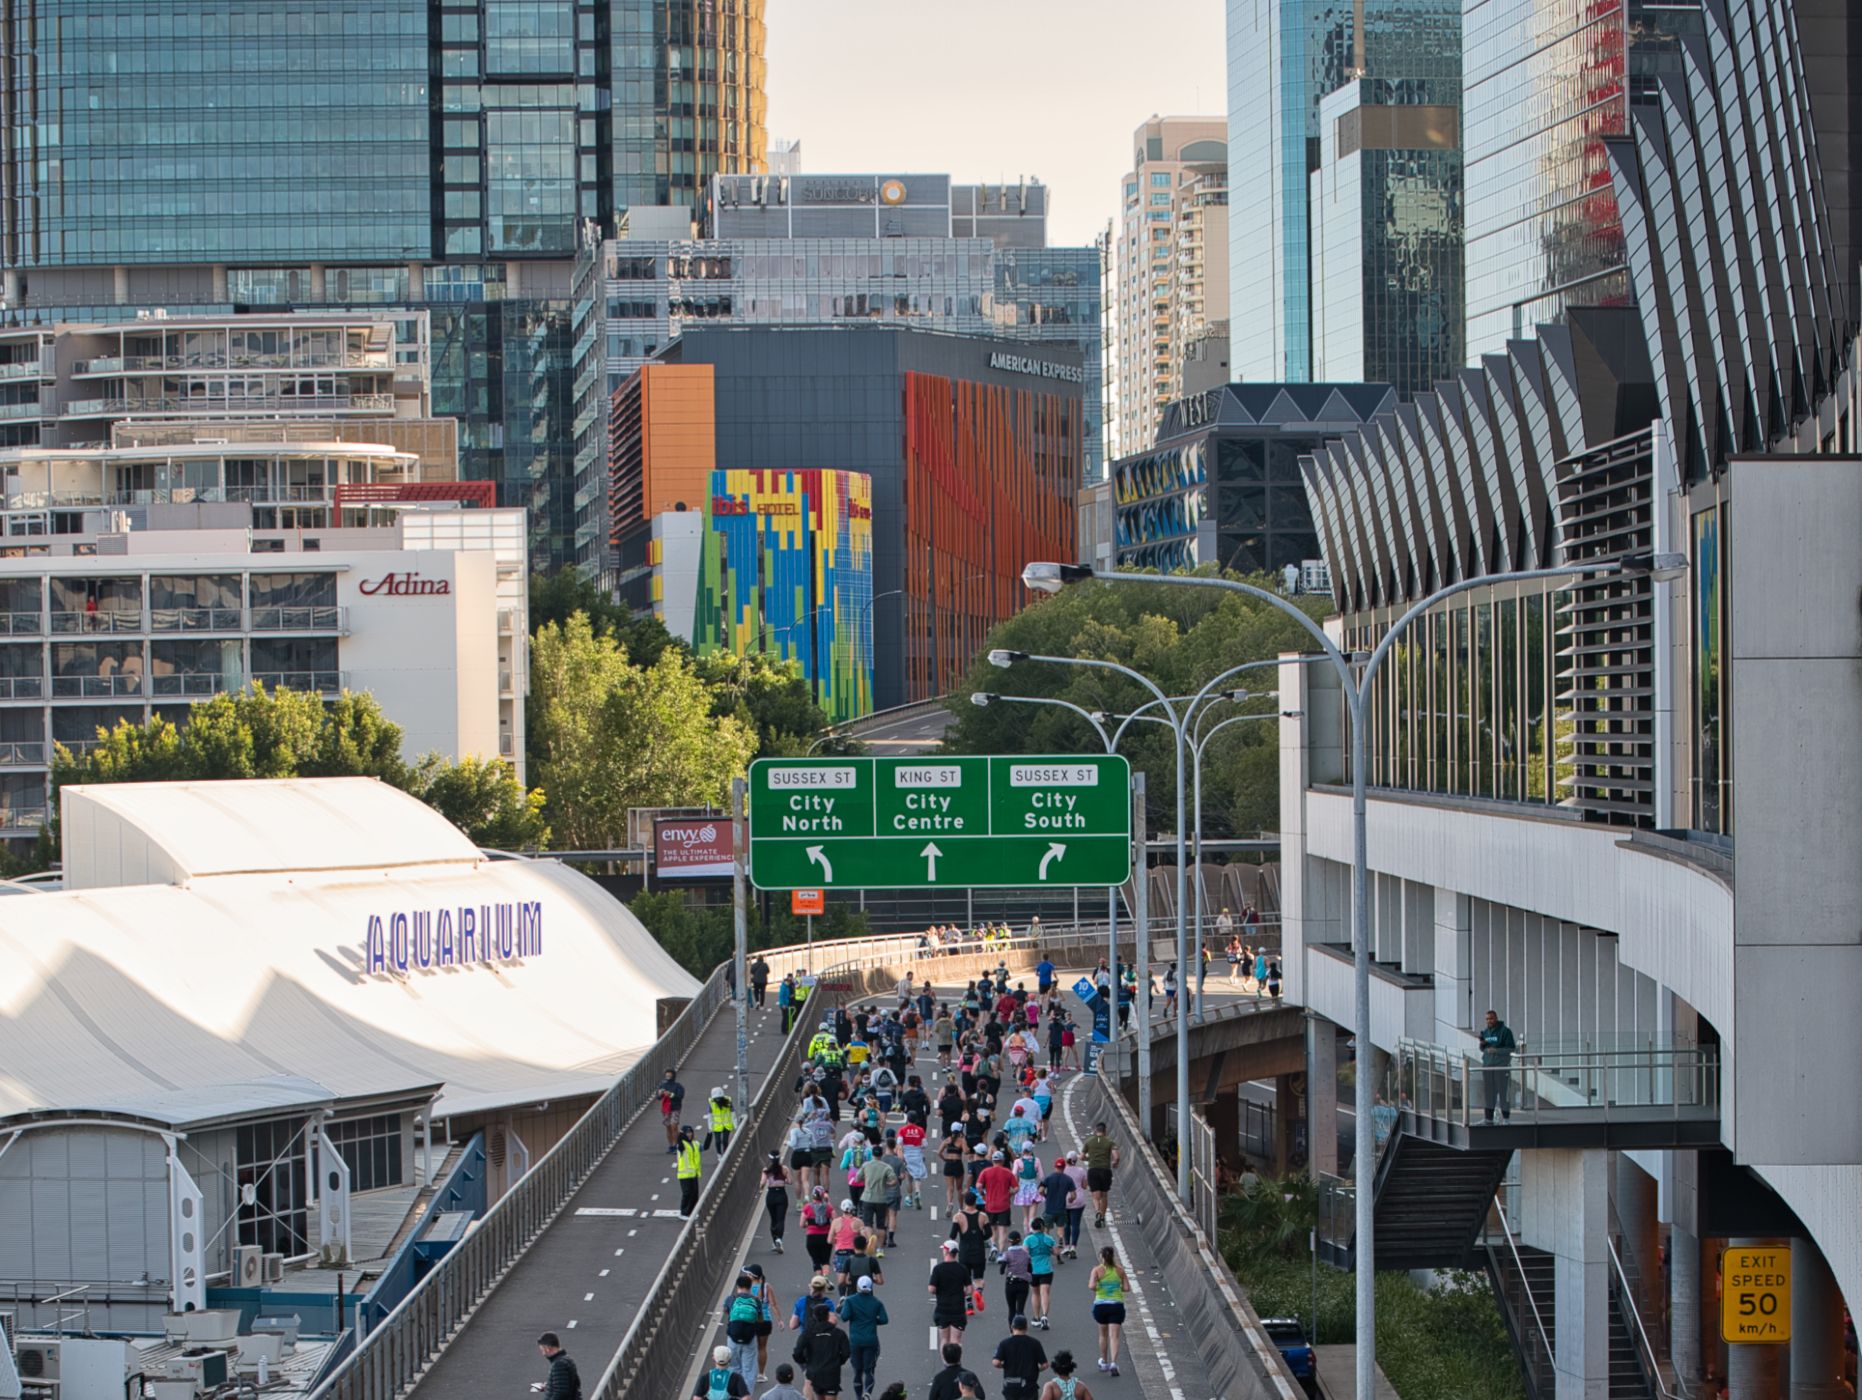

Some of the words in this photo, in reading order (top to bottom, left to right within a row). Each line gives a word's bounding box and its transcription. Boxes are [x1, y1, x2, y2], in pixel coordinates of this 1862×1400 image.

[990, 352, 1041, 376] AMERICAN
[1042, 361, 1083, 383] EXPRESS
[712, 495, 748, 516] ibis
[757, 503, 799, 515] HOTEL
[359, 572, 451, 596] Adina
[773, 772, 827, 785] SUSSEX
[834, 772, 851, 784] ST
[900, 771, 933, 783] KING
[940, 770, 957, 782] ST
[1015, 769, 1069, 782] SUSSEX
[1076, 769, 1094, 781] ST
[789, 794, 835, 814] City
[905, 793, 951, 813] City
[1031, 792, 1077, 811] City
[782, 815, 843, 832] North
[893, 814, 965, 830] Centre
[1024, 812, 1086, 829] South
[662, 828, 700, 849] envy
[680, 848, 717, 856] ULTIMATE
[366, 901, 542, 975] AQUARIUM
[1740, 1256, 1776, 1268] EXIT
[1731, 1274, 1786, 1287] SPEED
[1739, 1293, 1777, 1315] 50
[1739, 1322, 1777, 1336] km/h
